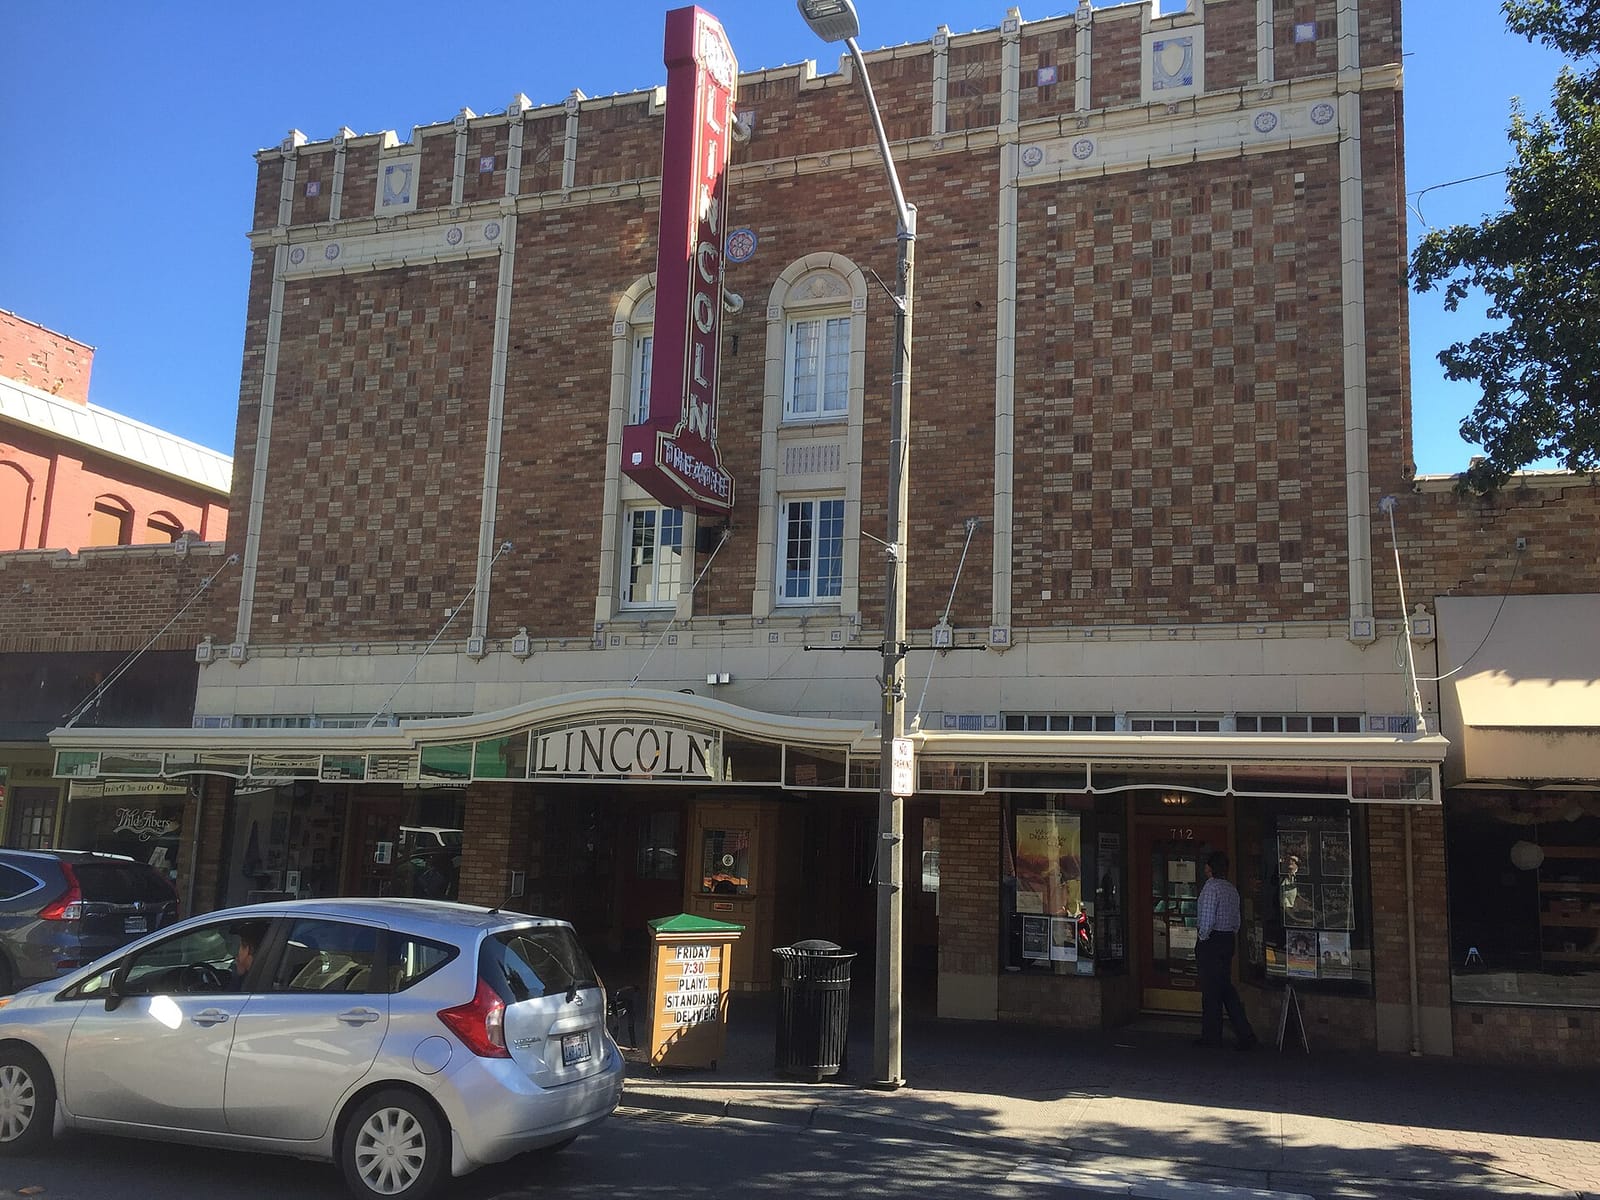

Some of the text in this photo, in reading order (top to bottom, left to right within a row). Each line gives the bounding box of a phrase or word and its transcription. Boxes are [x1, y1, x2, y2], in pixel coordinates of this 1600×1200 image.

[689, 85, 723, 441] LINCOLN
[538, 727, 712, 773] LINCOLN
[1170, 828, 1194, 840] 712
[676, 946, 711, 960] FRIDAY
[684, 962, 704, 974] 7:30
[676, 1008, 717, 1023] DELIVER
